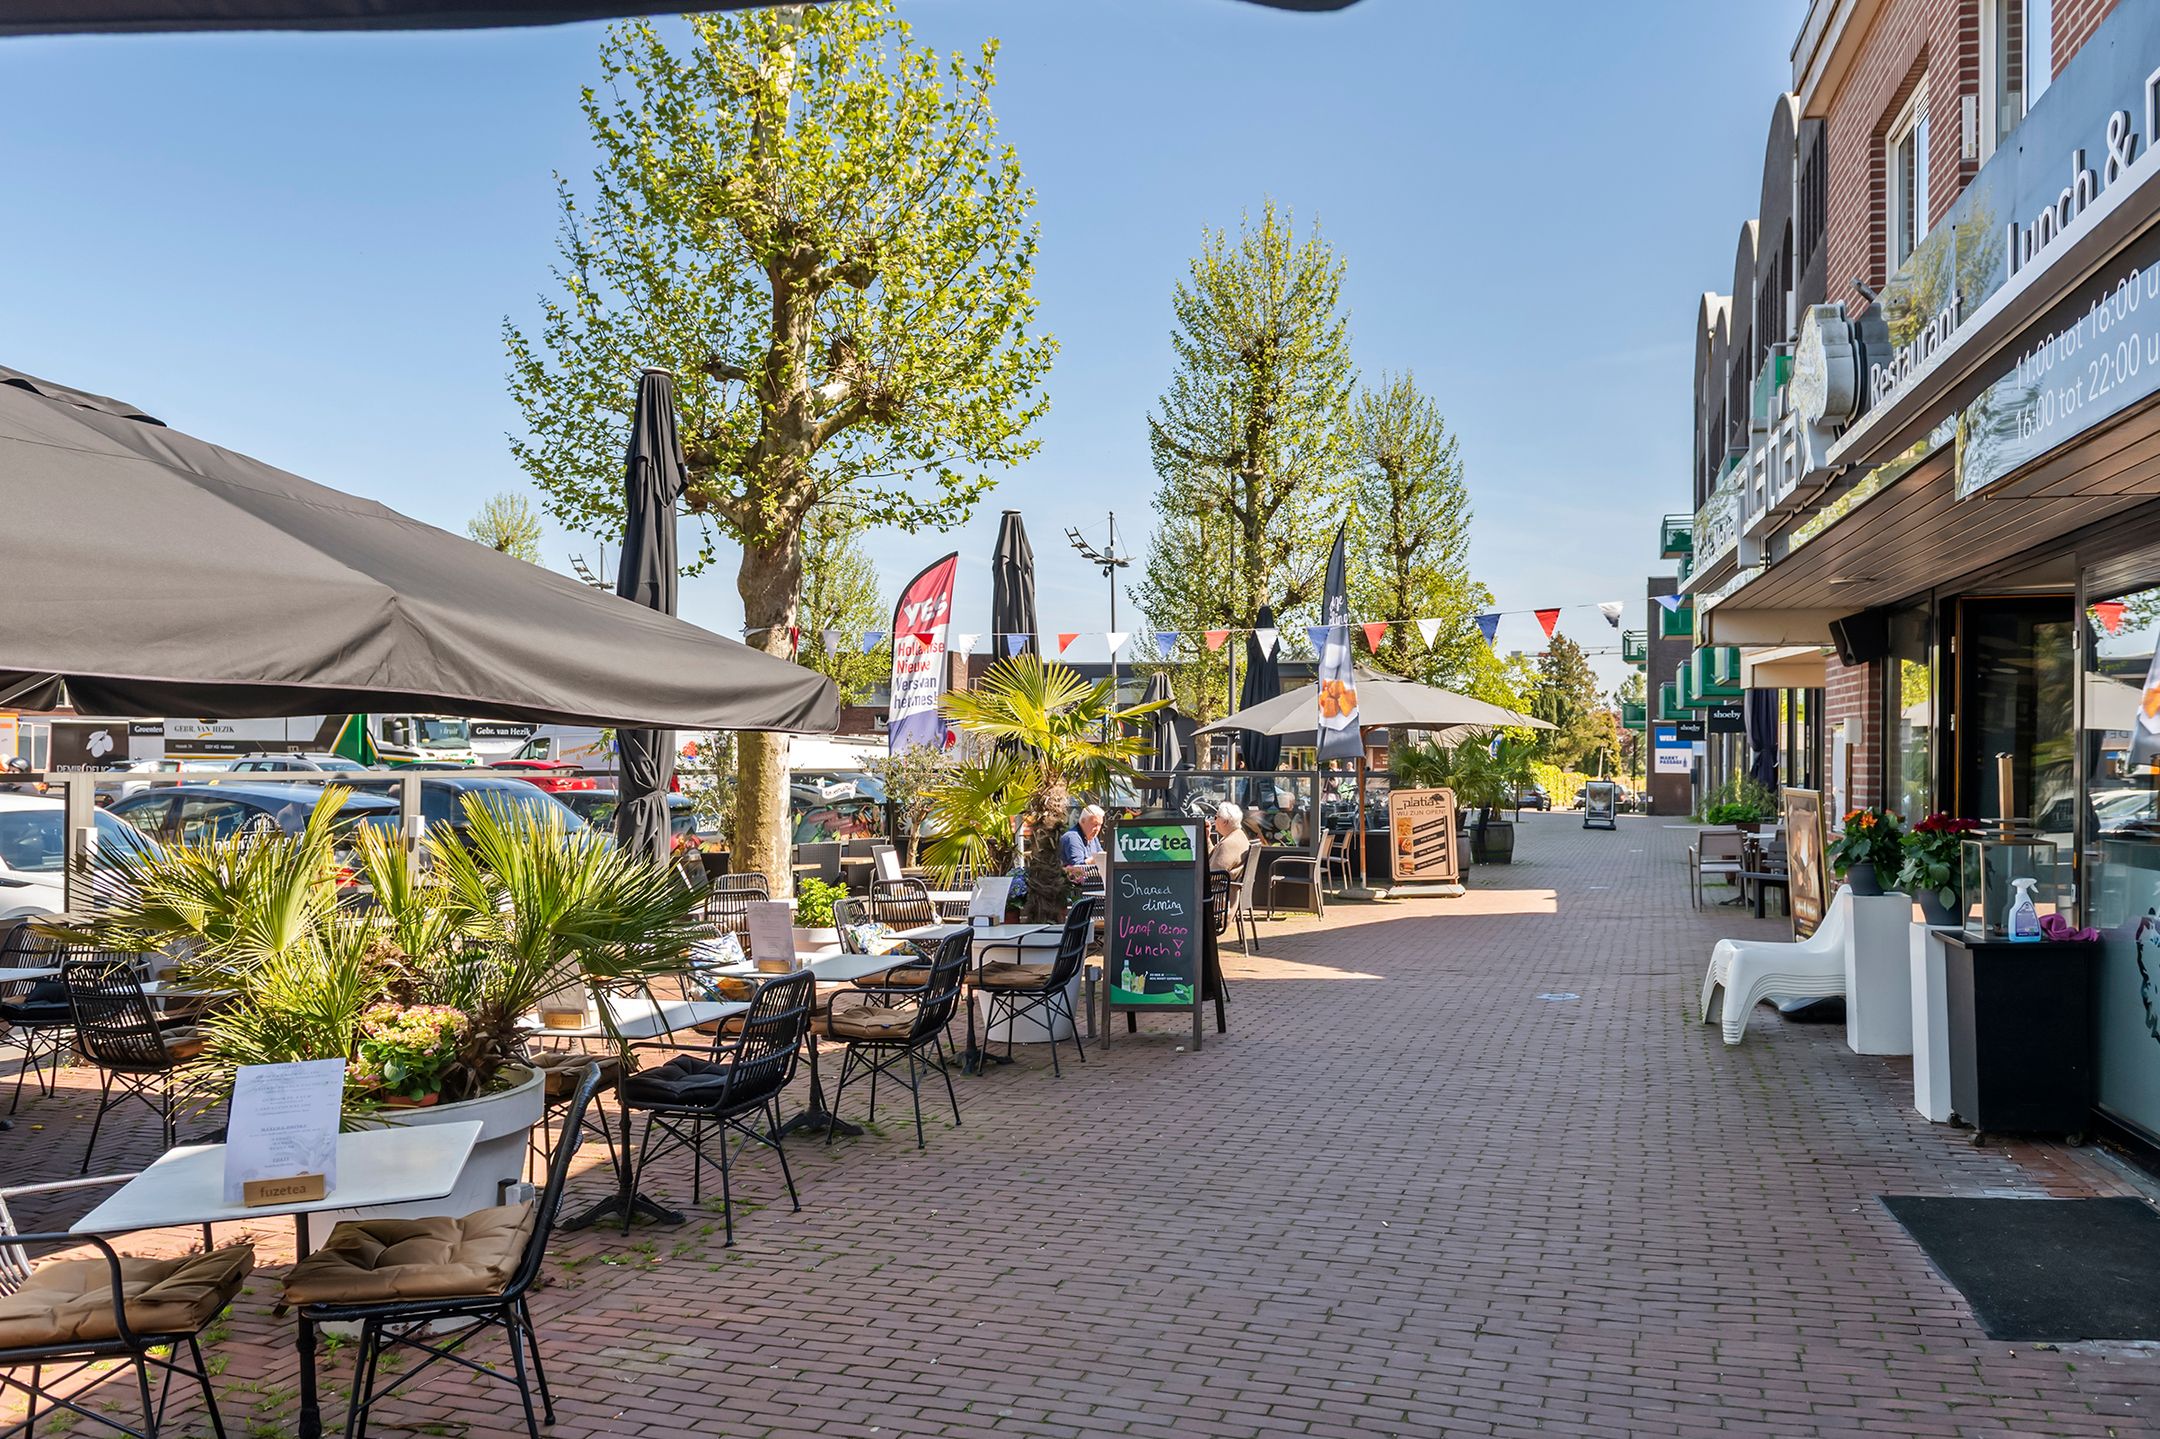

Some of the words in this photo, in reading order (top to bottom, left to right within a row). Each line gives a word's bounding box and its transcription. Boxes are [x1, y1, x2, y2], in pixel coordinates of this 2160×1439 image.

[2104, 111, 2139, 189] &
[2016, 333, 2055, 390] 11:00
[2060, 317, 2083, 361] tot
[2089, 268, 2140, 339] 16:00
[1871, 289, 1963, 409] Restaurant
[2015, 389, 2054, 444] 16:00
[2059, 376, 2083, 419] tot
[2088, 333, 2140, 402] 22:00
[903, 592, 948, 627] YES
[897, 641, 945, 657] Hollase
[896, 678, 919, 691] Vers
[920, 677, 937, 688] van
[1713, 710, 1741, 720] shoeby
[1402, 796, 1435, 810] platia
[1120, 833, 1192, 852] fuzetea
[1121, 873, 1172, 898] Shared
[1119, 915, 1155, 938] Vanaf
[260, 1184, 307, 1198] fuzetea
